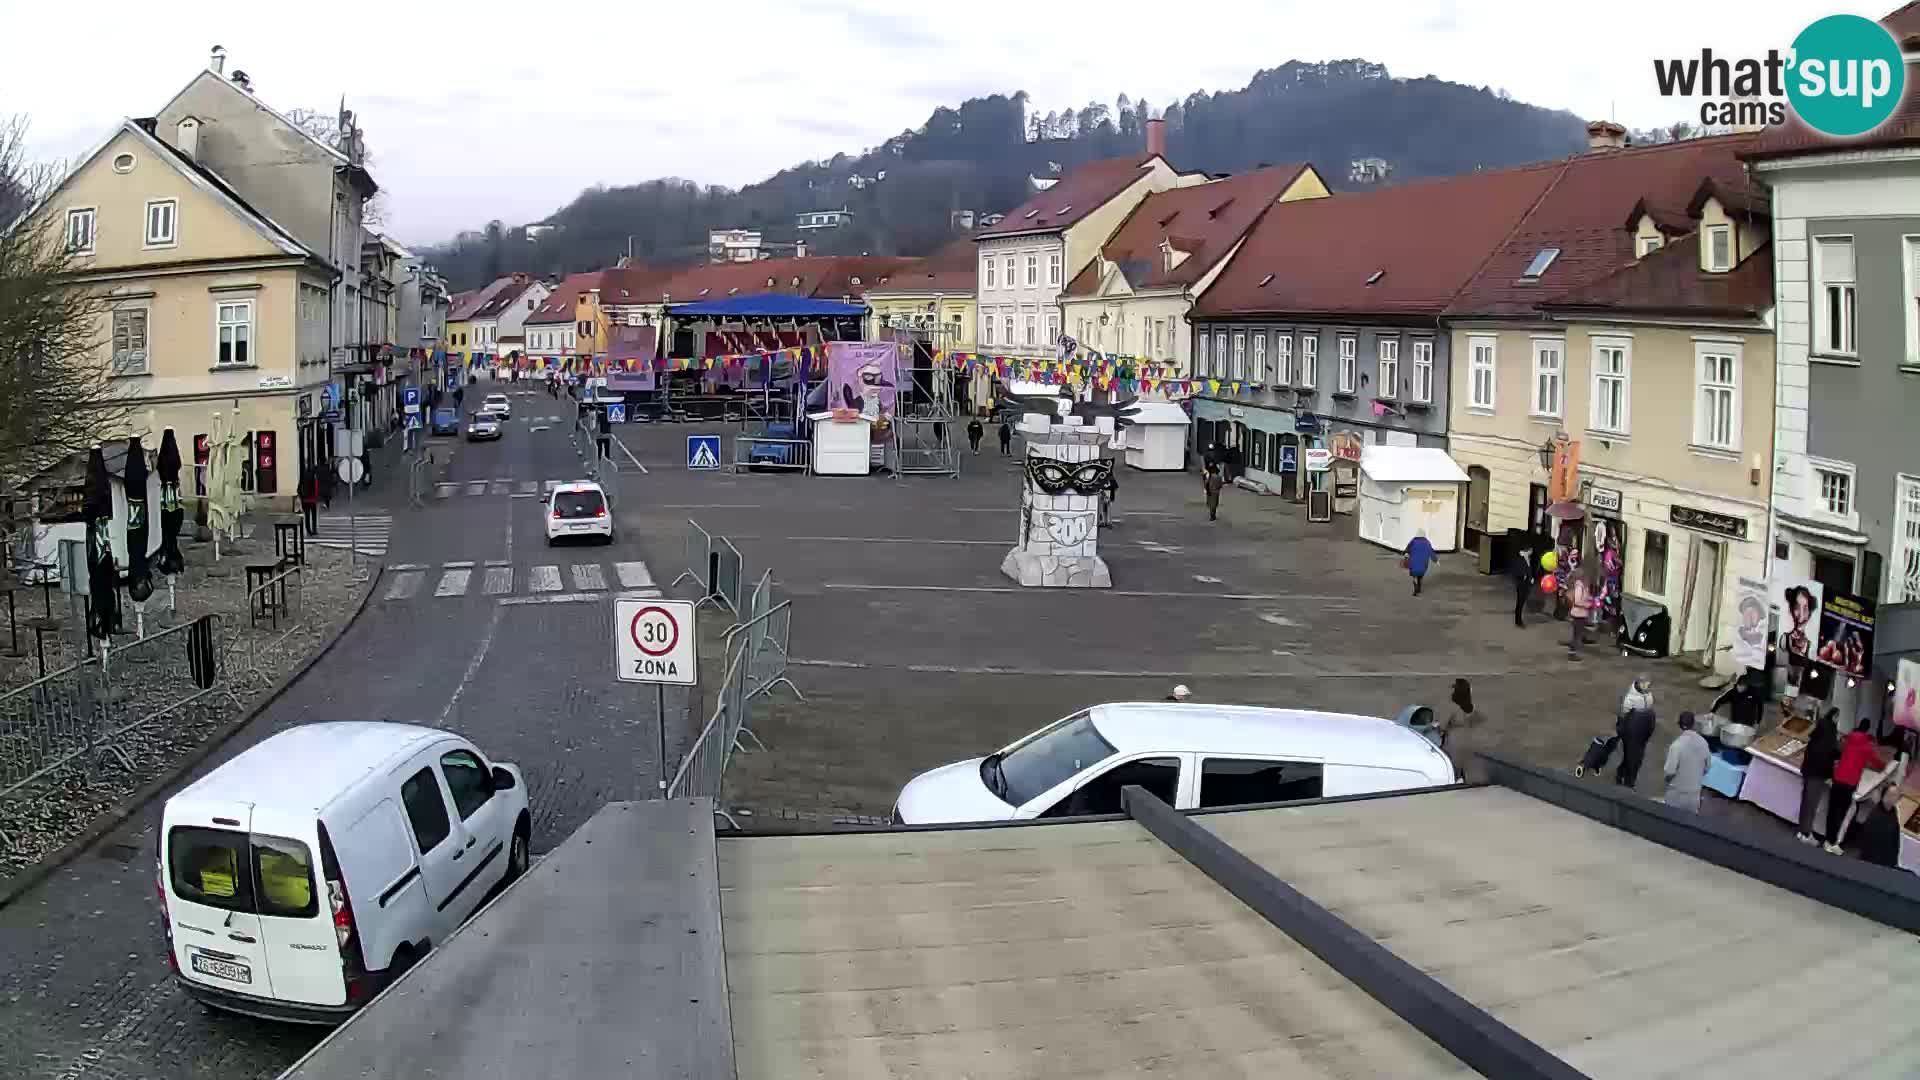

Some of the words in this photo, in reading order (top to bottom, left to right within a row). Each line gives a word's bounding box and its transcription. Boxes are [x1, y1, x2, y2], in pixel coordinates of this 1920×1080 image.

[407, 391, 416, 402] P
[643, 621, 668, 642] 30
[633, 659, 678, 676] ZONA
